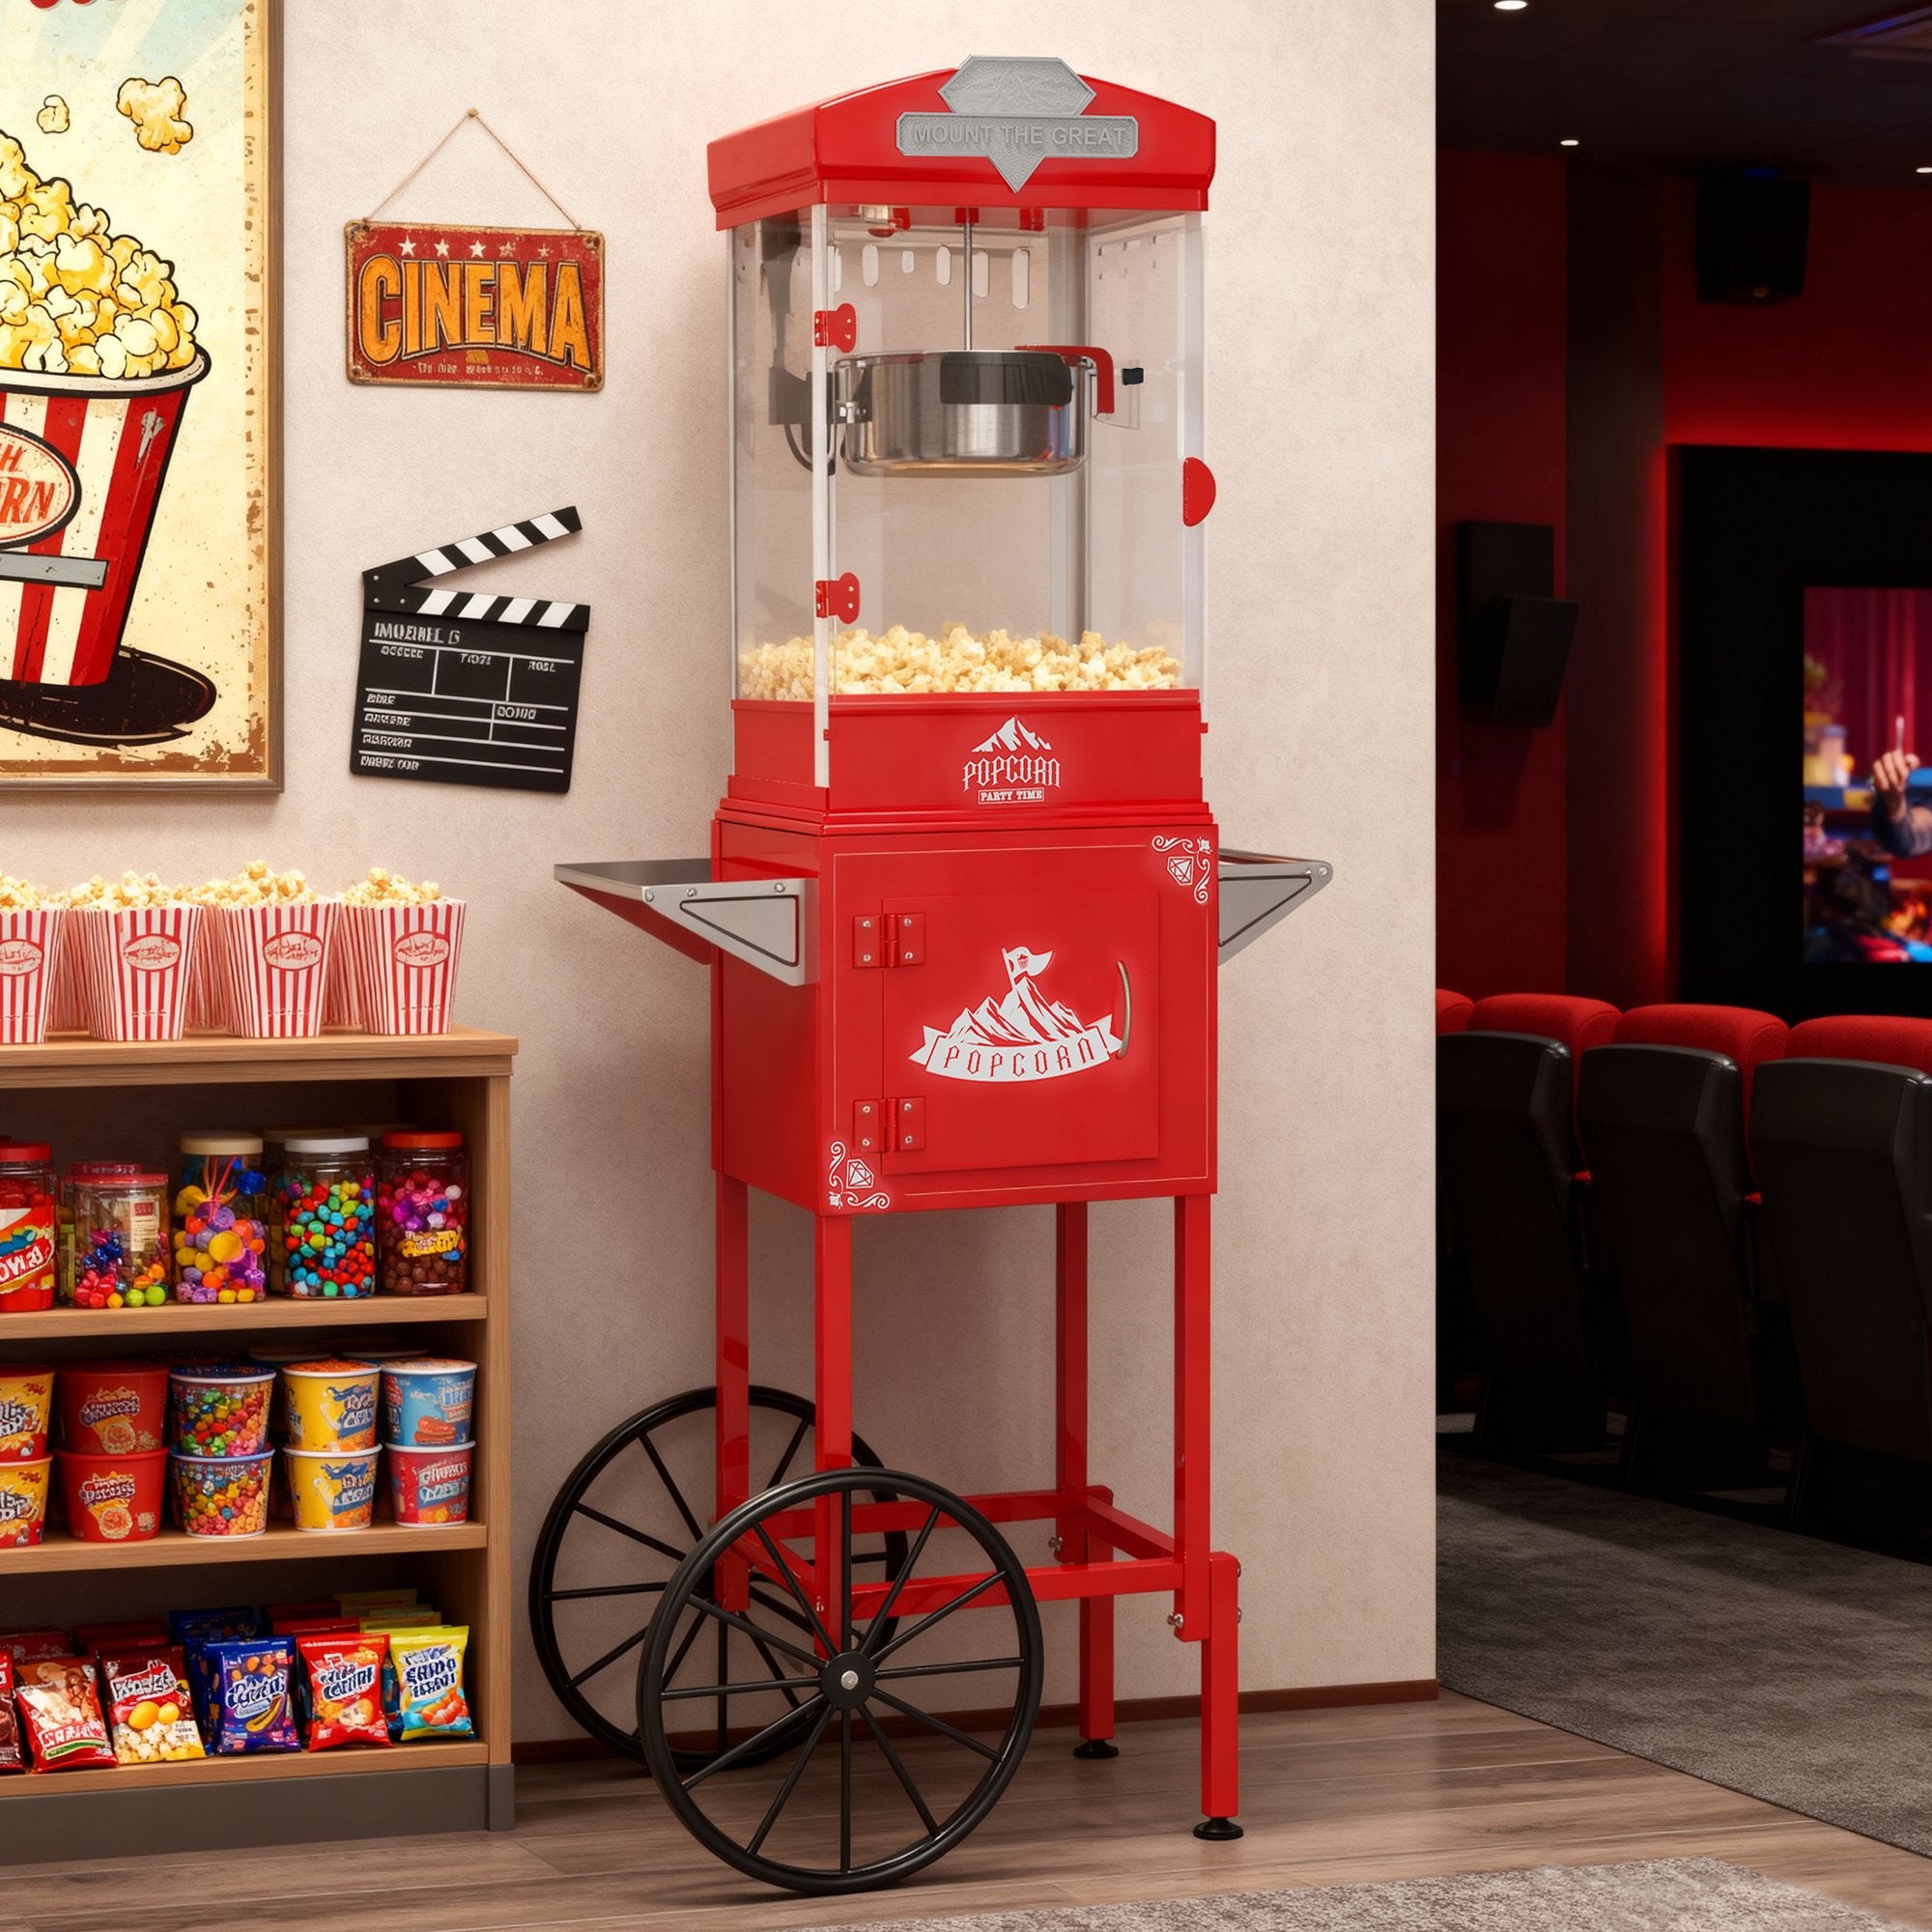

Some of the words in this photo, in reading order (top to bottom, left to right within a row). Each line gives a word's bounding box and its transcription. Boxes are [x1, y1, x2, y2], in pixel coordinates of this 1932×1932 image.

[914, 124, 992, 144] MOUNT
[1001, 125, 1043, 145] THE
[1051, 127, 1126, 146] GREAT
[358, 253, 591, 373] CINEMA
[962, 754, 1061, 792] POPCORN
[980, 790, 1012, 802] PARTY
[1016, 790, 1042, 801] TIME
[943, 1037, 1095, 1077] POPCORN
